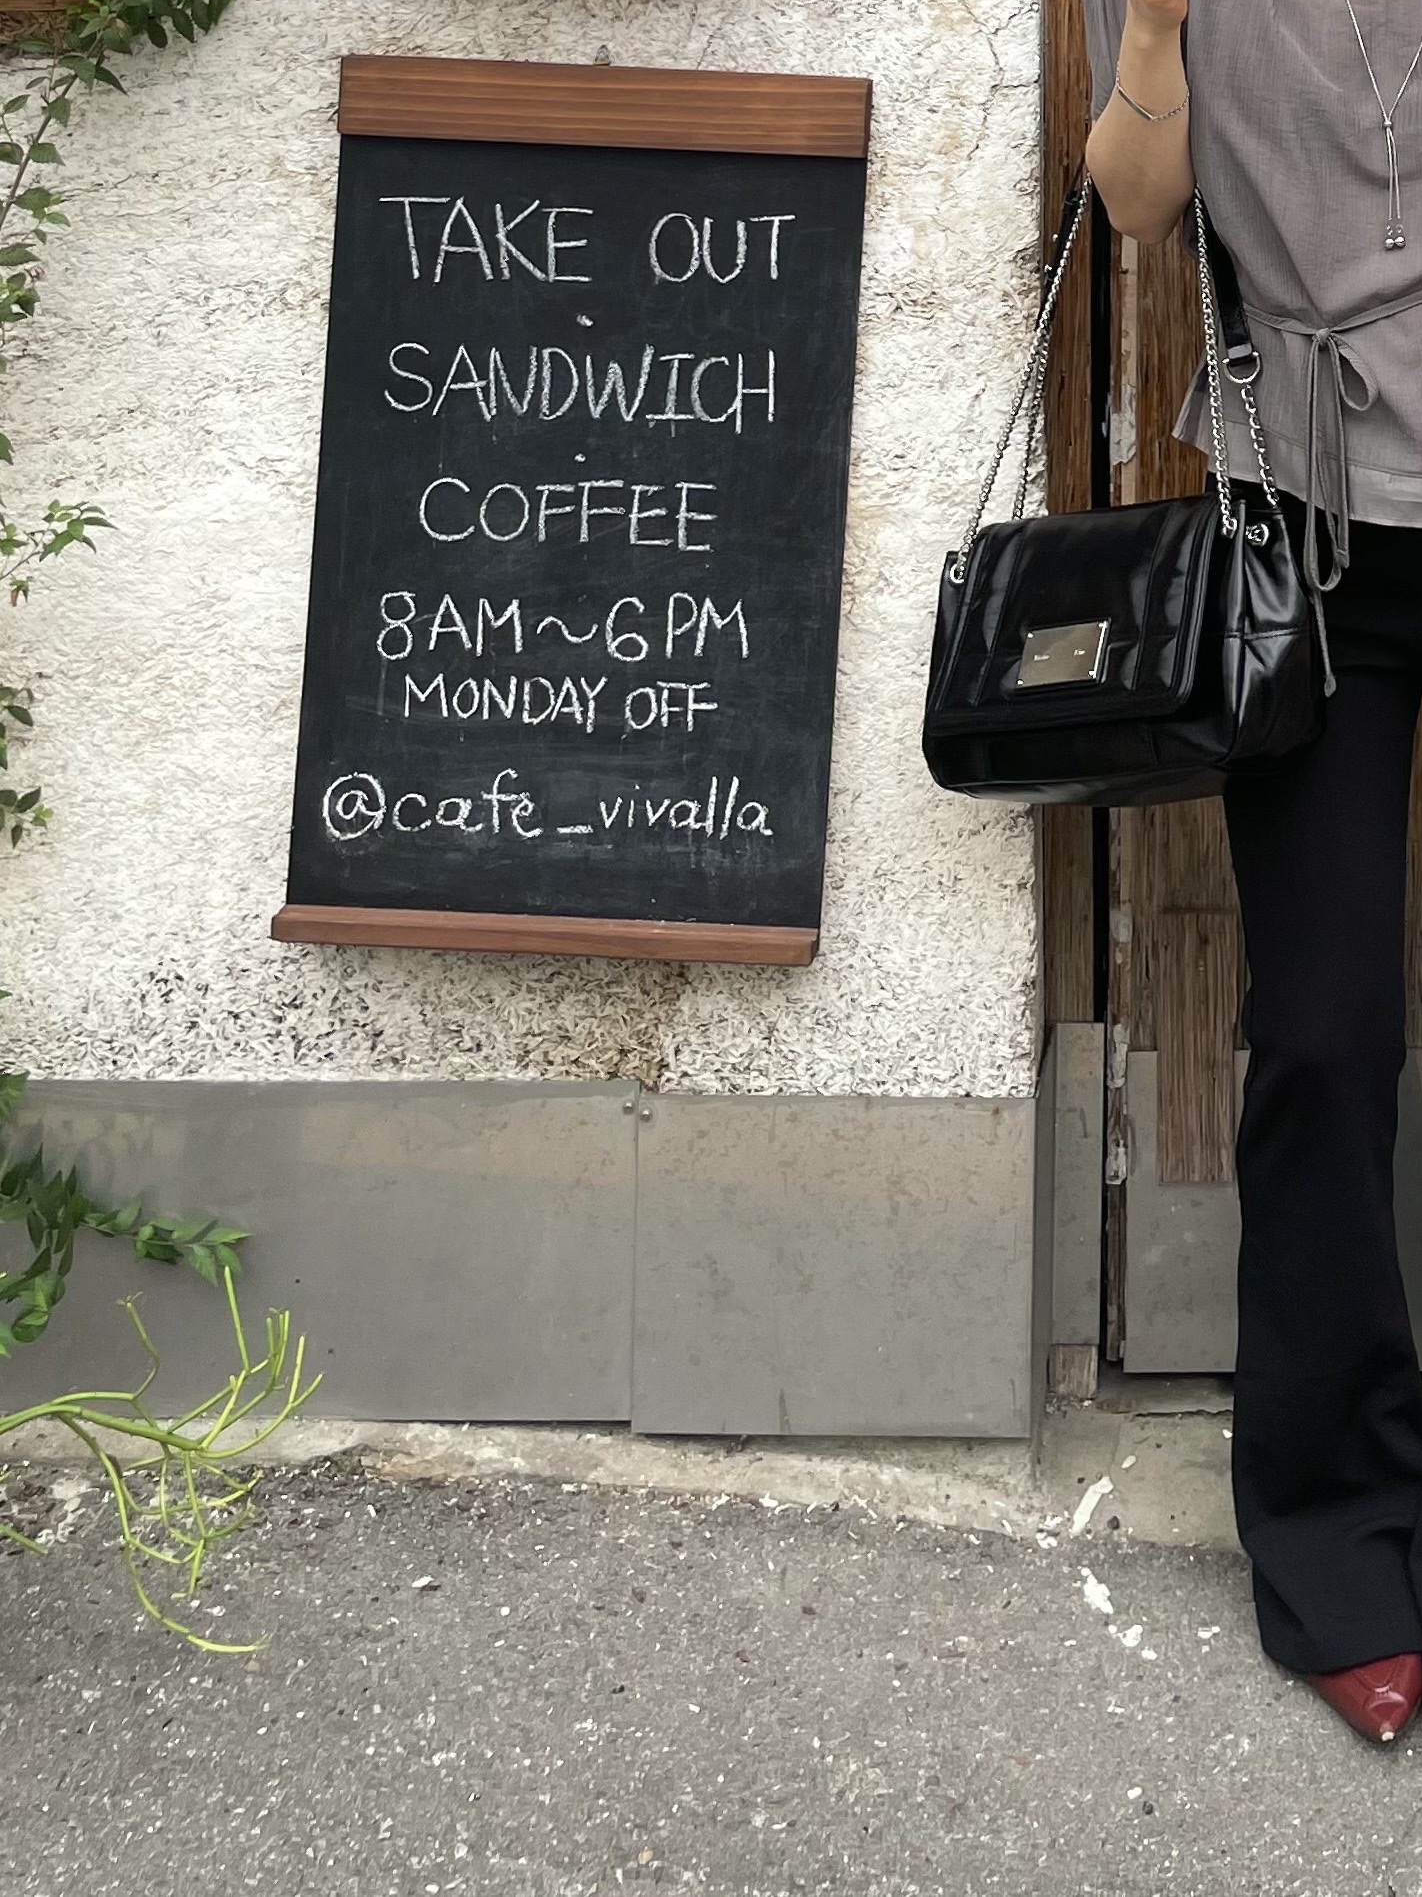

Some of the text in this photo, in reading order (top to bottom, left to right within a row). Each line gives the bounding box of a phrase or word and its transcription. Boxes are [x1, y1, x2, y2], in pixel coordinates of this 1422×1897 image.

[378, 196, 796, 284] TAKE OUT
[385, 343, 775, 435] SANDWICH
[420, 478, 717, 551] COFFEE
[405, 674, 719, 734] MONDAY OFF
[322, 768, 774, 841] @cafe_vivalla
